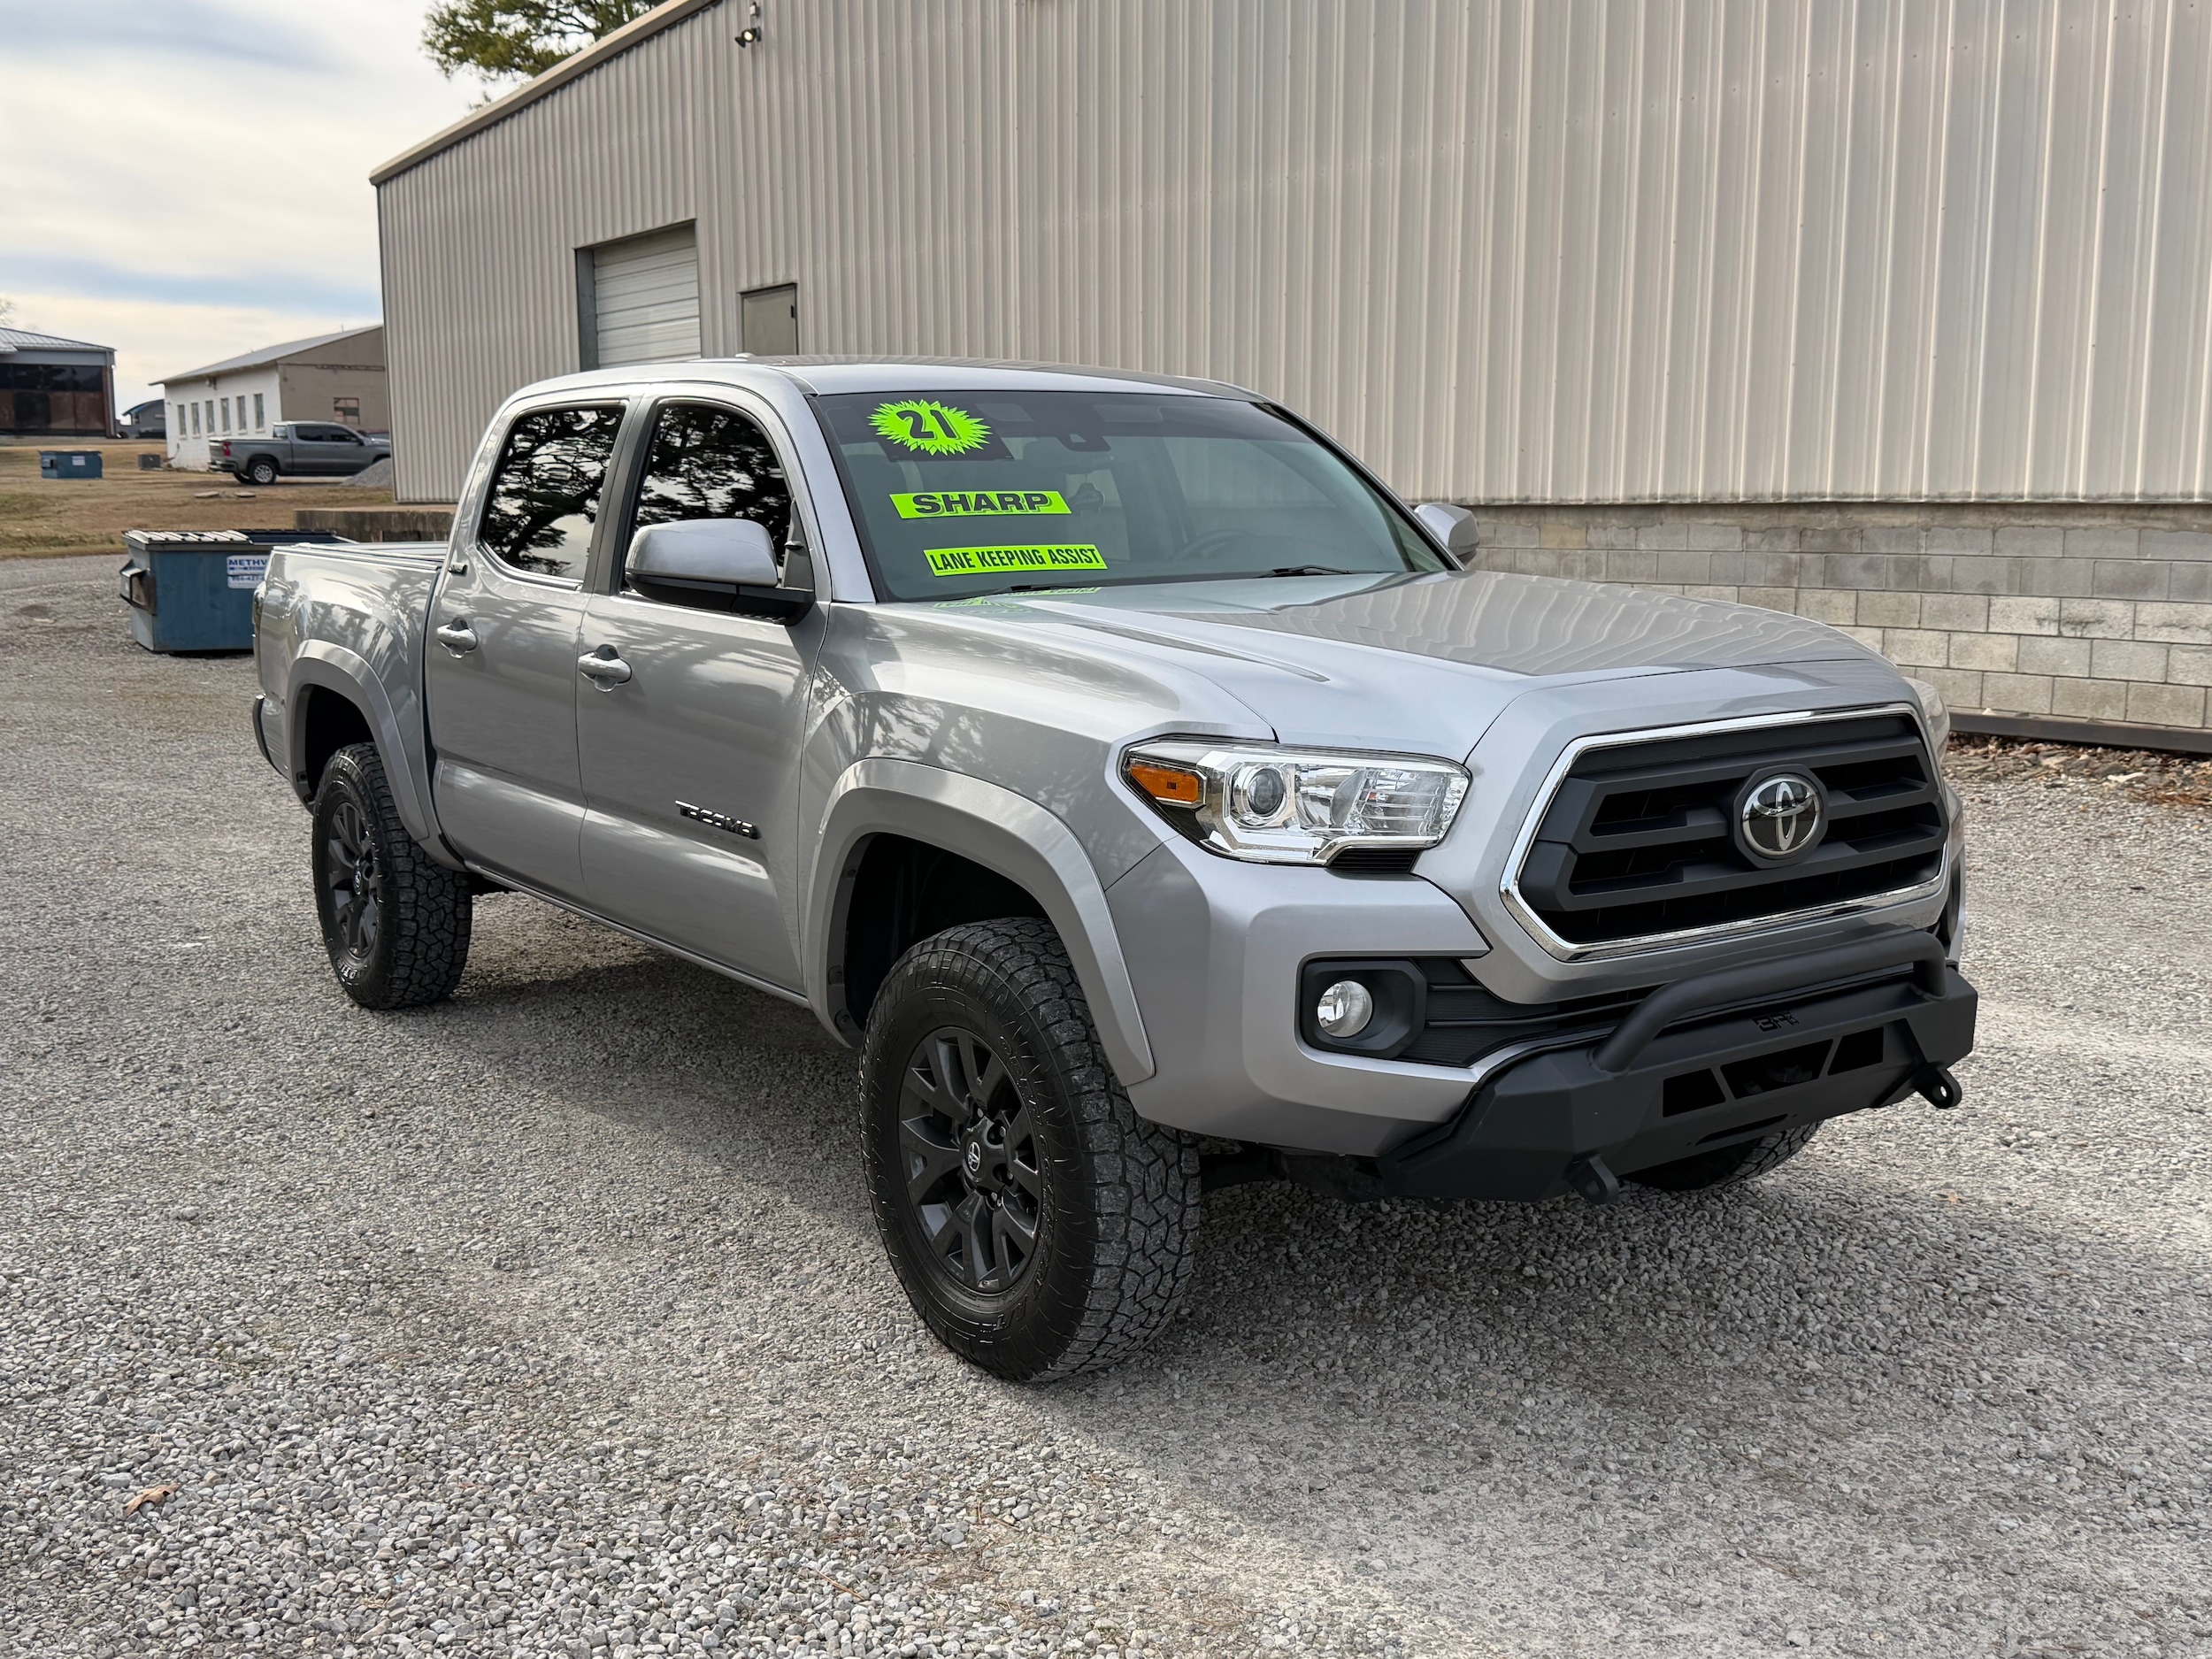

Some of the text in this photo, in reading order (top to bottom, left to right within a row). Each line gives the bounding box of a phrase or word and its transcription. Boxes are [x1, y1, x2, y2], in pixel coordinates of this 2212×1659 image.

[895, 410, 962, 440] 21
[912, 493, 1053, 515] SHARP
[929, 549, 1101, 571] LANE KEEPING ASSIST
[675, 800, 762, 840] TACOMA
